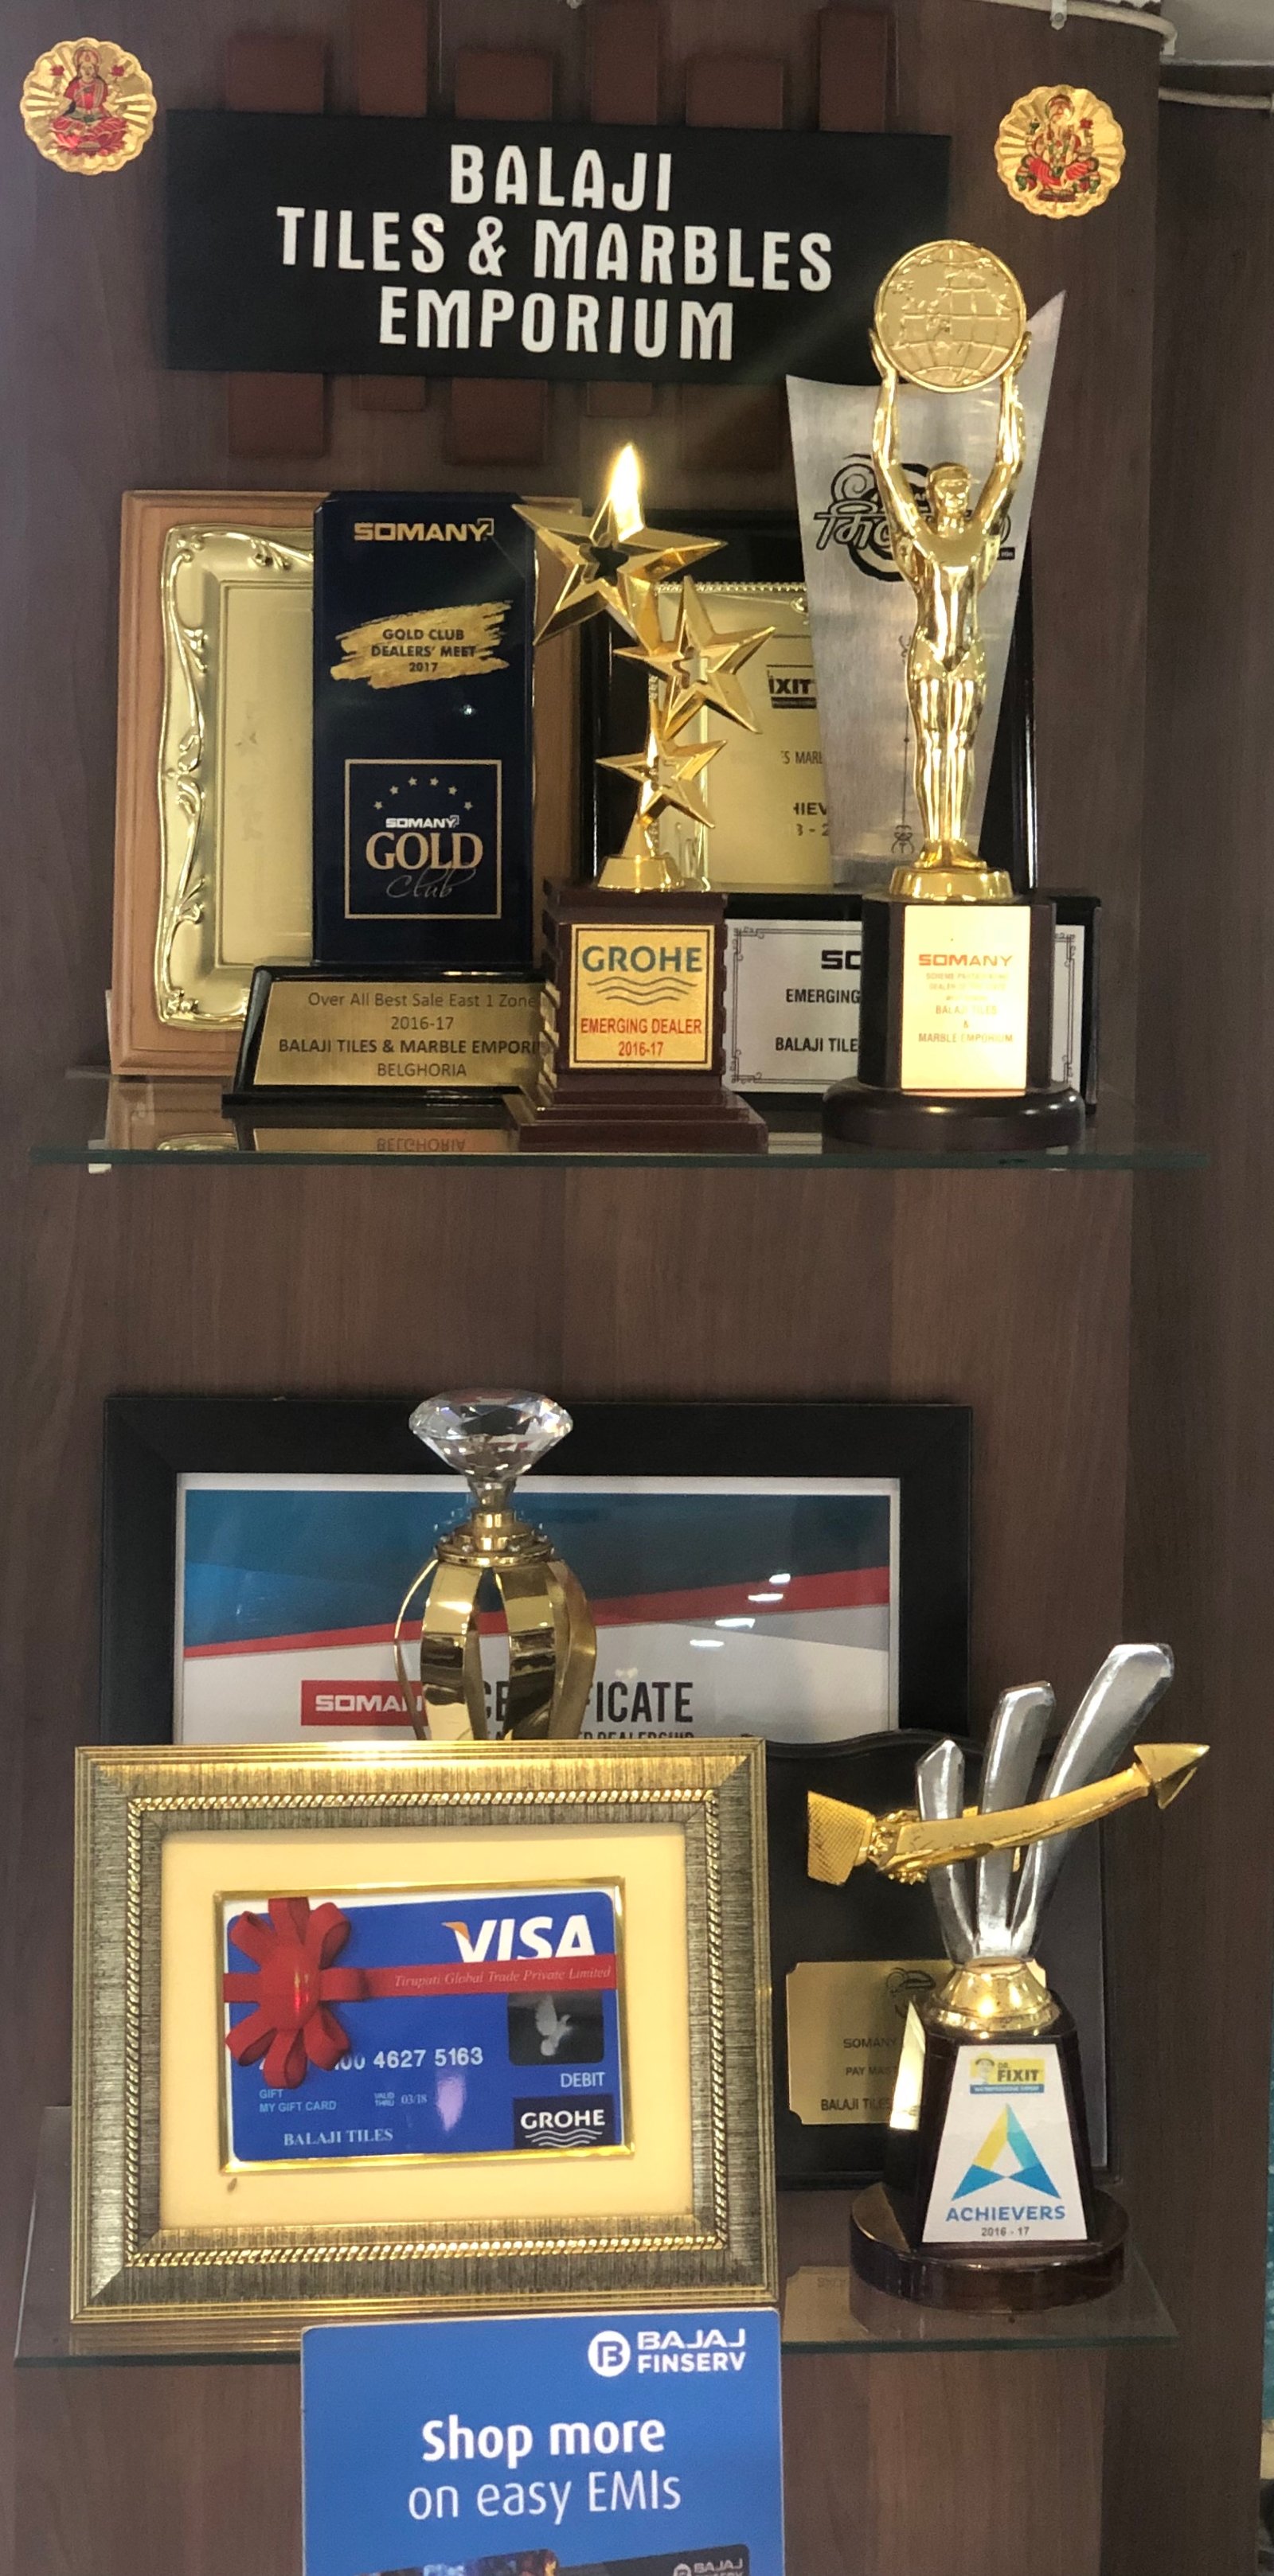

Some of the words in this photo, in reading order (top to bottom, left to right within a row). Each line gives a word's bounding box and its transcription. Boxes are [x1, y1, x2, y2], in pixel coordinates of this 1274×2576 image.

[451, 144, 671, 212] BALAJI
[276, 207, 444, 273] TILES
[469, 216, 506, 277] &
[533, 219, 832, 292] MARBLES
[379, 286, 733, 361] EMPORIUM
[354, 521, 490, 541] SOMANY
[382, 629, 424, 641] GOLD
[428, 629, 464, 641] CLUB
[440, 646, 476, 657] MEET
[408, 662, 438, 673] 2017
[768, 678, 810, 695] IXIT
[385, 818, 456, 829] SOMANY
[365, 832, 483, 870] GOLD
[385, 868, 476, 899] Club
[582, 946, 702, 973] GROHE
[918, 954, 1013, 966] SOMANY
[308, 993, 344, 1006] Over
[350, 992, 369, 1006] All
[374, 993, 408, 1007] Best
[412, 993, 443, 1007] Sale
[449, 993, 479, 1007] East
[487, 994, 492, 1006] 1
[498, 993, 535, 1007] Zone
[786, 989, 861, 1003] EMERGING
[391, 1016, 454, 1030] 2016-17
[580, 1018, 648, 1034] EMERGING
[651, 1018, 702, 1034] DEALER
[775, 1037, 823, 1052] BALAJI
[828, 1038, 858, 1052] TILE
[918, 1033, 957, 1043] MARBLE
[960, 1033, 1013, 1043] EMPORIUM
[279, 1039, 332, 1053] BALAJI
[336, 1039, 377, 1053] TILES
[382, 1040, 395, 1053] &
[400, 1040, 467, 1054] MARBLE
[618, 1041, 663, 1057] 2016-17
[377, 1063, 467, 1077] BELGHORIA
[442, 1914, 596, 1963] VISA
[395, 1975, 440, 1989] Tirupati
[444, 1972, 483, 1985] Global
[488, 1970, 518, 1982] Trade
[523, 1969, 565, 1981] Private
[569, 1965, 612, 1979] Limited
[843, 2037, 897, 2049] SOMANY
[373, 2049, 427, 2068] 4627
[435, 2047, 483, 2067] 5163
[846, 2067, 866, 2076] PAY
[997, 2070, 1039, 2082] FIXIT
[561, 2072, 605, 2088] DEBIT
[259, 2089, 283, 2099] GIFT
[401, 2094, 428, 2105] 03/18
[260, 2102, 276, 2113] MY
[279, 2102, 302, 2112] GIFT
[305, 2100, 337, 2111] CARD
[821, 2098, 858, 2110] BALAJI
[520, 2109, 605, 2129] GROHE
[283, 2130, 342, 2146] BALAJI
[346, 2128, 393, 2143] TILES
[945, 2205, 1065, 2222] ACHIEVERS
[982, 2227, 1006, 2237] 2016
[1018, 2227, 1030, 2236] 17
[637, 2328, 747, 2350] BAJAJ
[637, 2352, 747, 2375] FINSERV
[423, 2414, 533, 2469] Shop
[549, 2418, 666, 2456] more
[408, 2484, 458, 2520] on
[478, 2479, 572, 2526] easy
[588, 2469, 682, 2513] EMIs
[694, 2558, 744, 2574] BAJAJ
